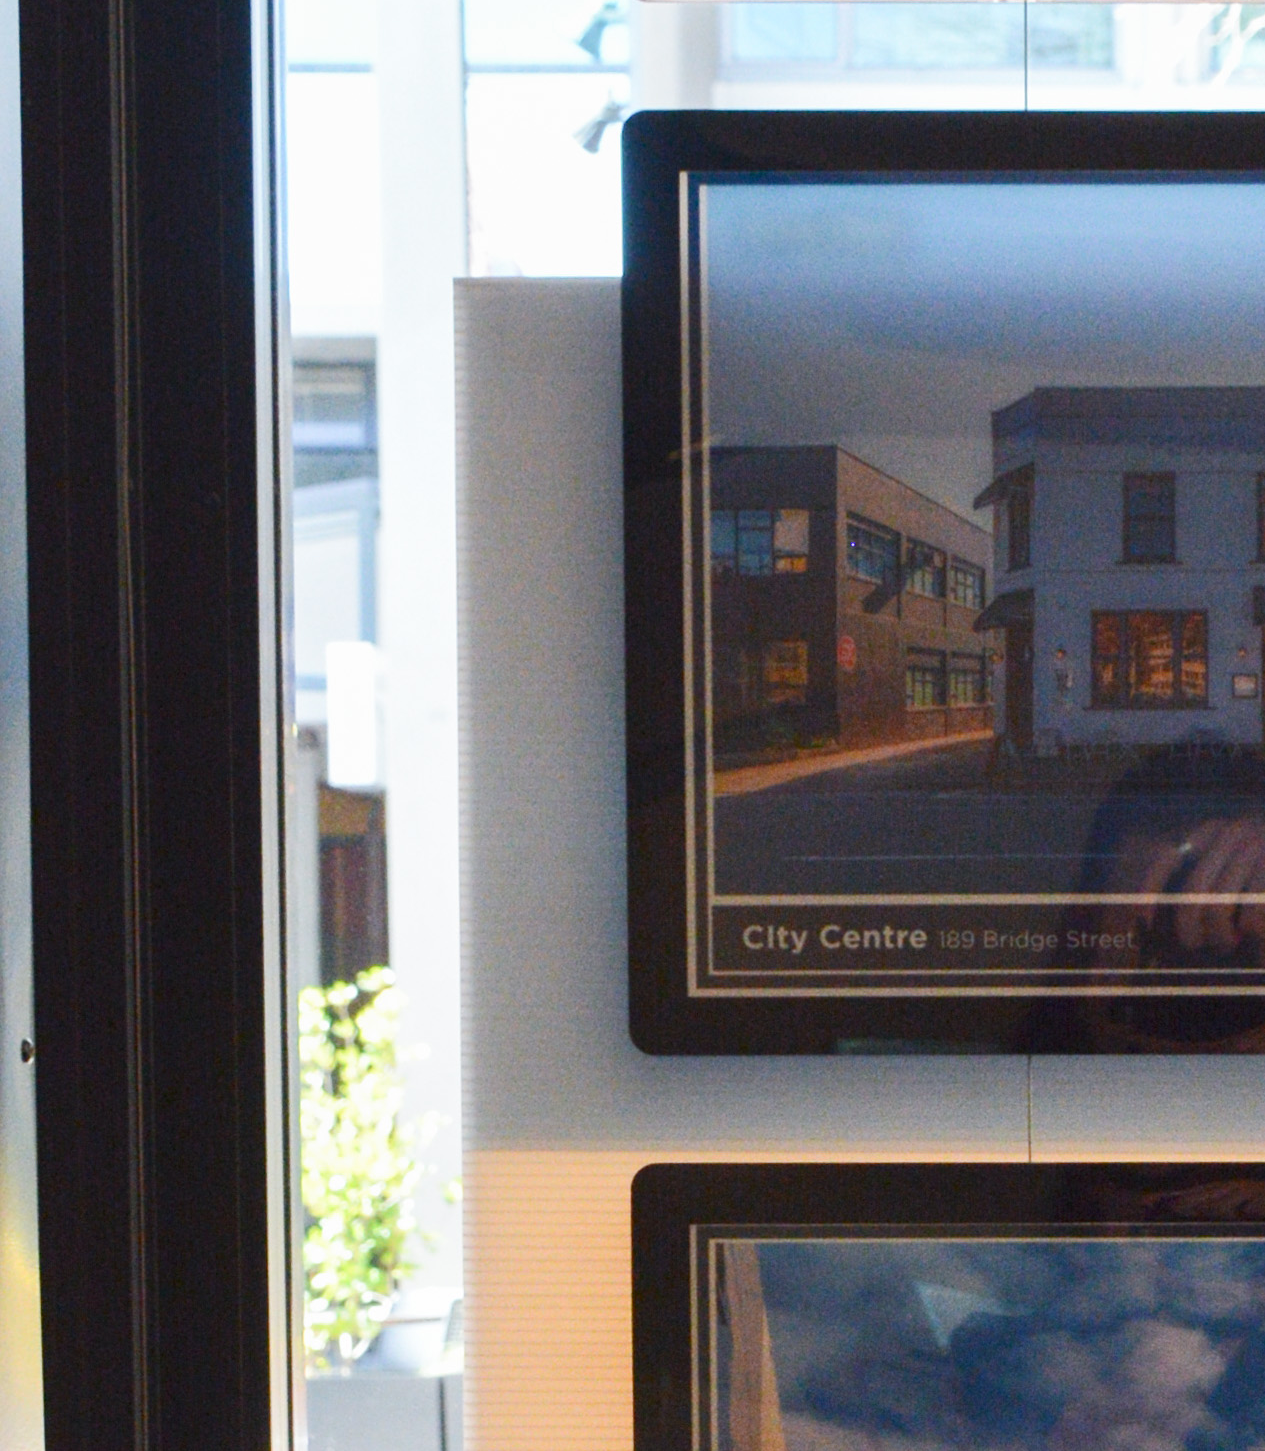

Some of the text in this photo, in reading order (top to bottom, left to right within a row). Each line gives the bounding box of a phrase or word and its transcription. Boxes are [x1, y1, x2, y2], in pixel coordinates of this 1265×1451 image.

[742, 924, 1134, 954] City Centre 189 Bridge Street
